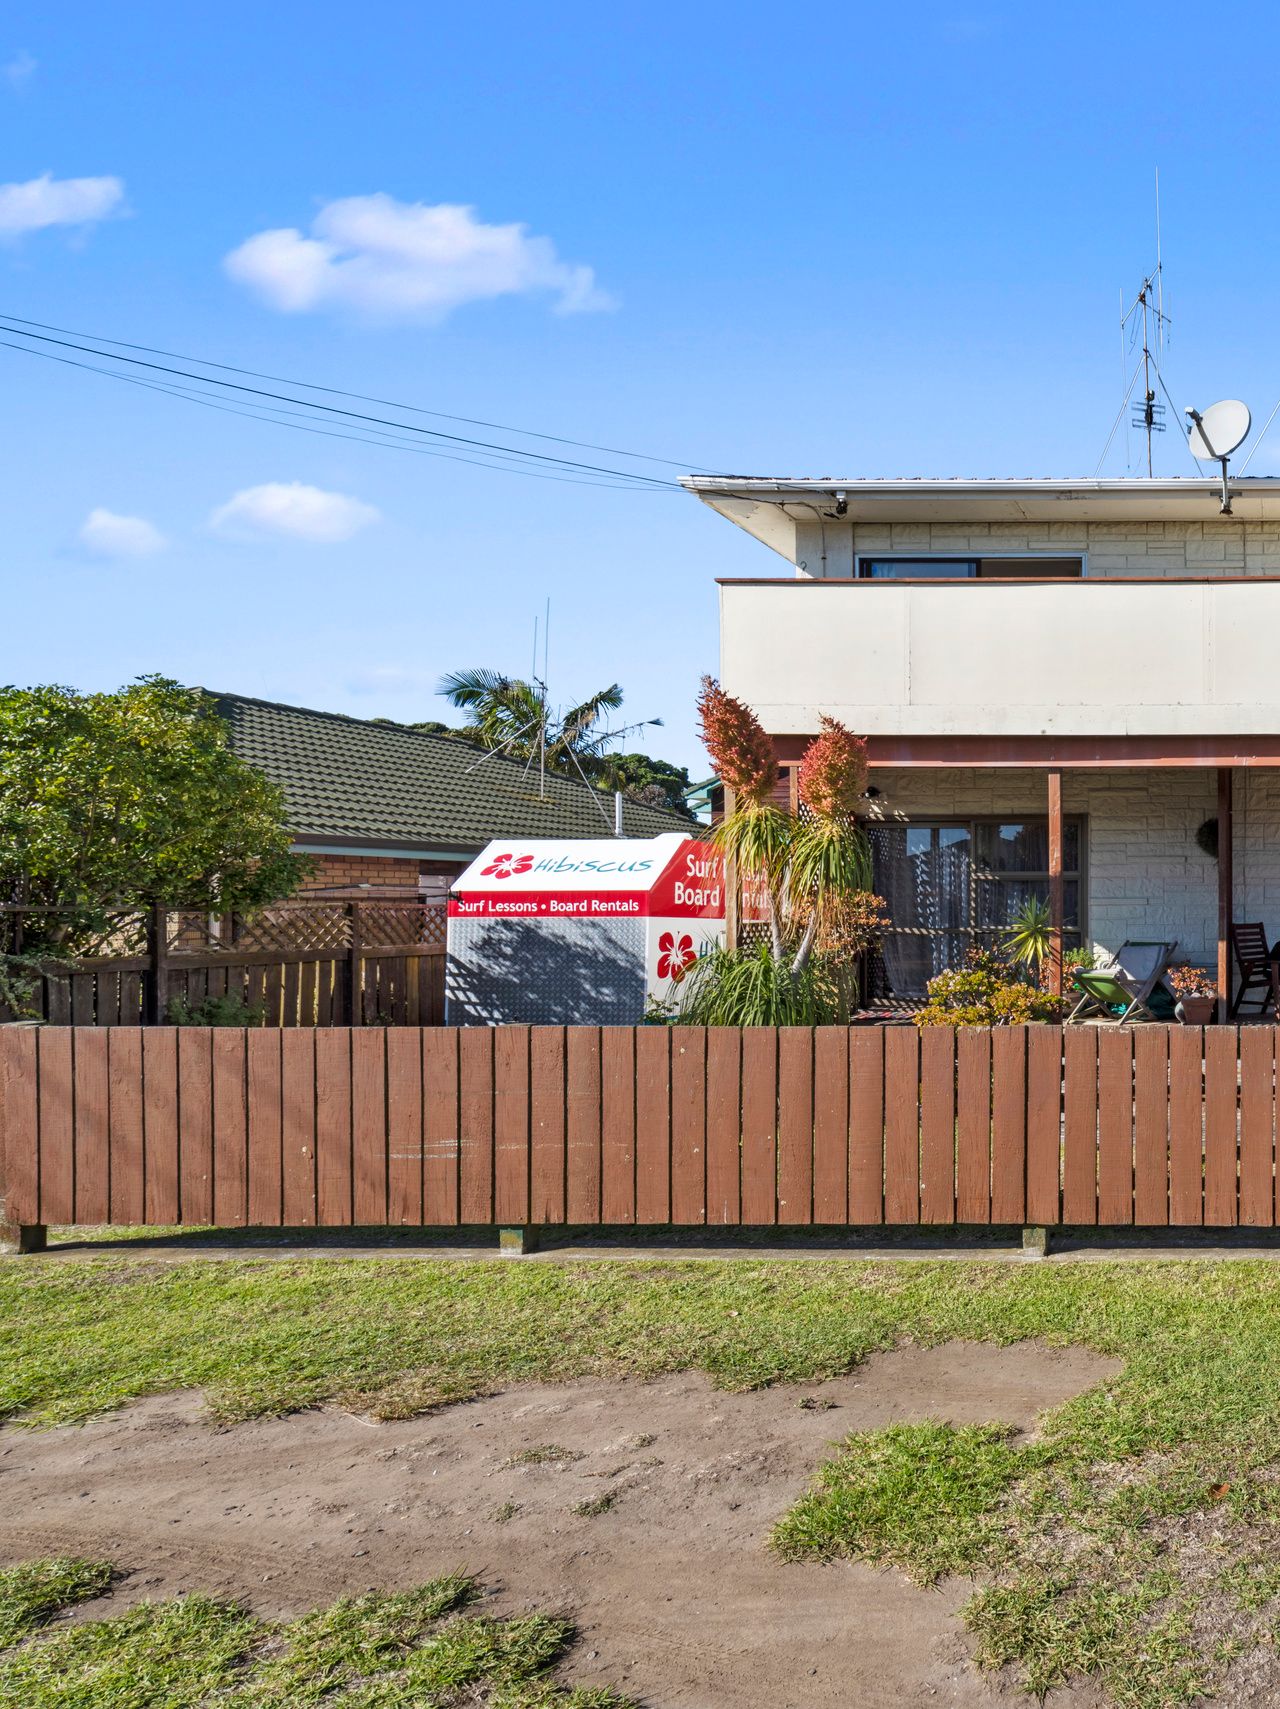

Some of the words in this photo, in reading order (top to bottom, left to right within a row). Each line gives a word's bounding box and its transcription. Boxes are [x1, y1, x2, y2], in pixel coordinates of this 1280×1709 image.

[534, 855, 655, 873] Hibiscus
[687, 853, 720, 880] Surf
[674, 881, 720, 907] Board
[458, 899, 485, 912] Surf
[488, 900, 537, 912] Lessons
[550, 899, 588, 912] Board
[591, 899, 639, 912] Rentals
